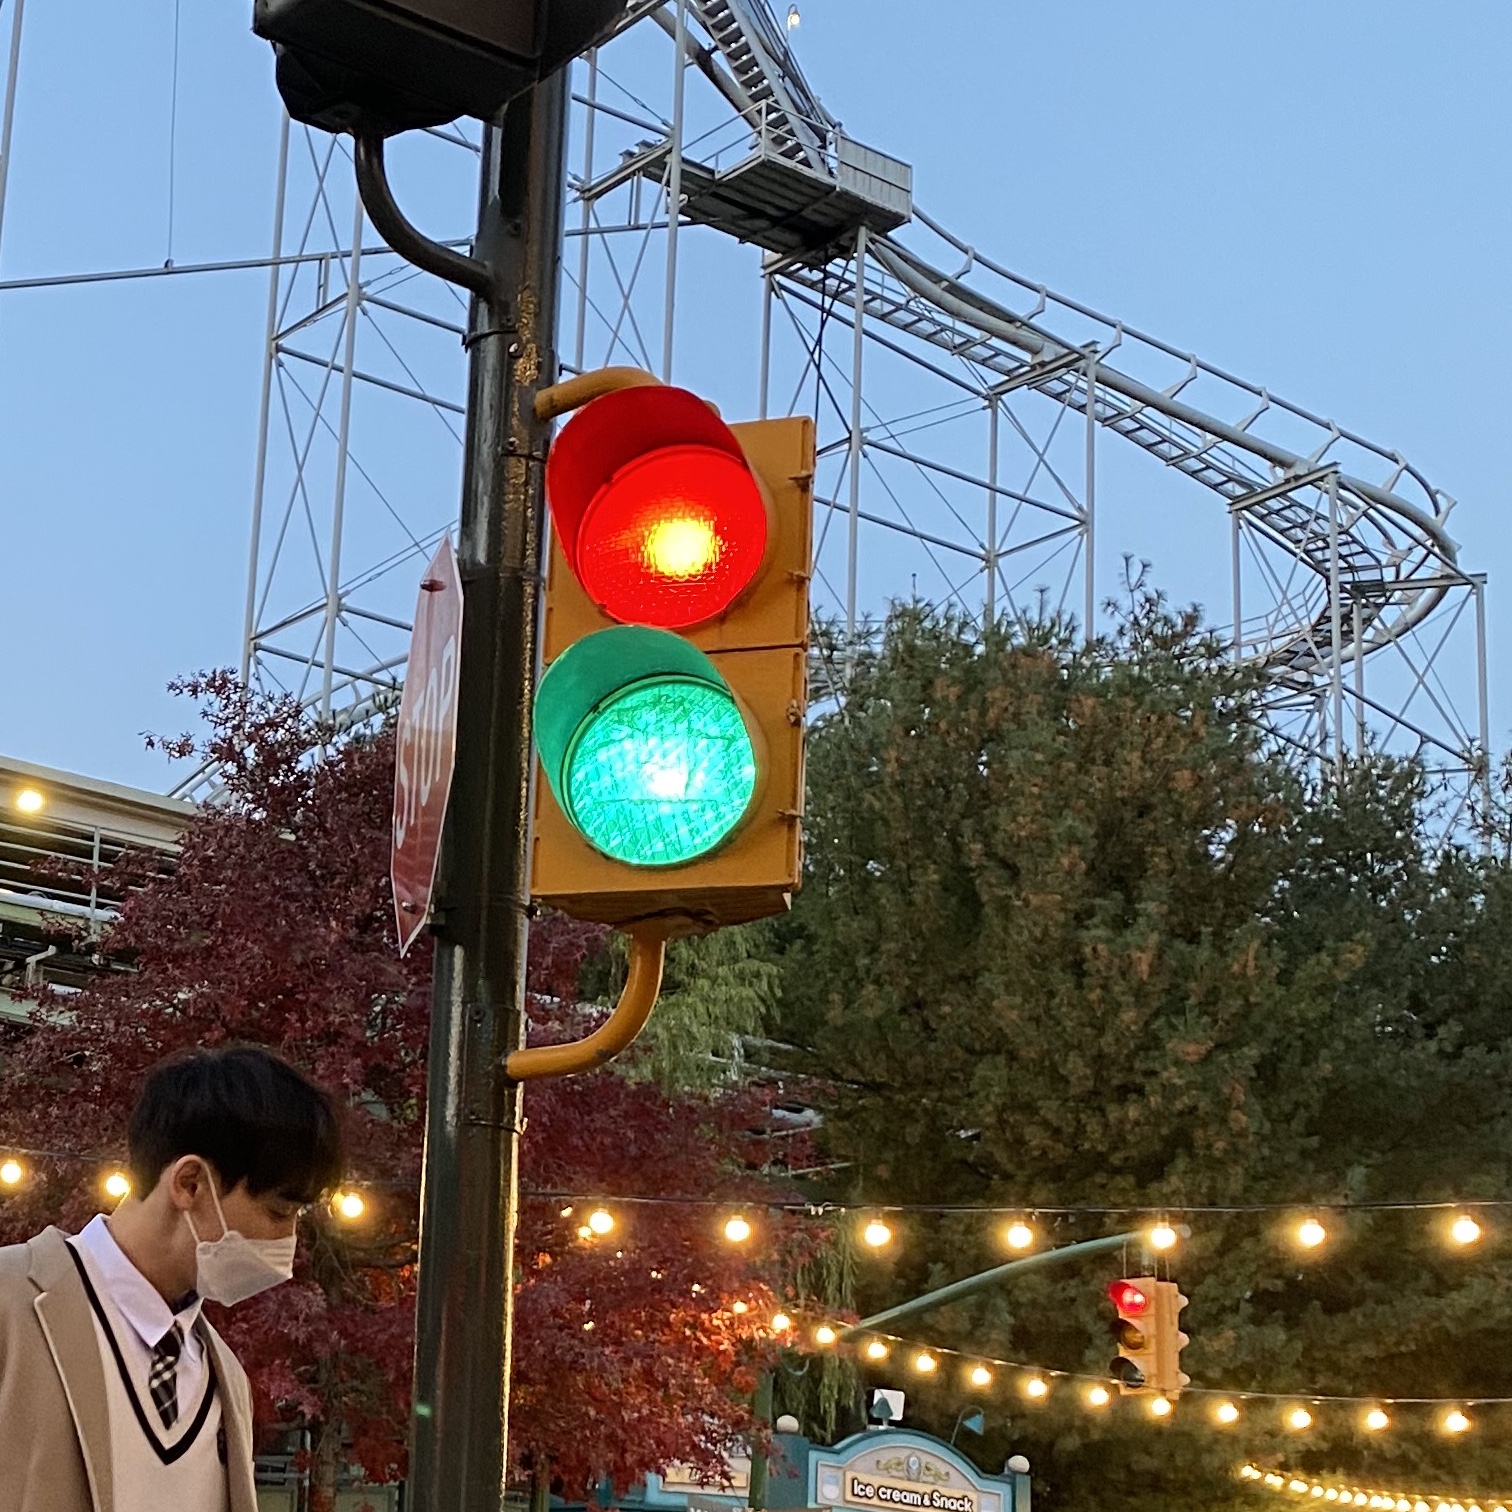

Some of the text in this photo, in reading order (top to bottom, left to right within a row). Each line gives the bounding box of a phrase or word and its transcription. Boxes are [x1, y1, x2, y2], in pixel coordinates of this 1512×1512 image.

[396, 635, 456, 850] STOP
[852, 1479, 875, 1499] Ice
[877, 1485, 922, 1506] cream
[922, 1493, 932, 1507] &
